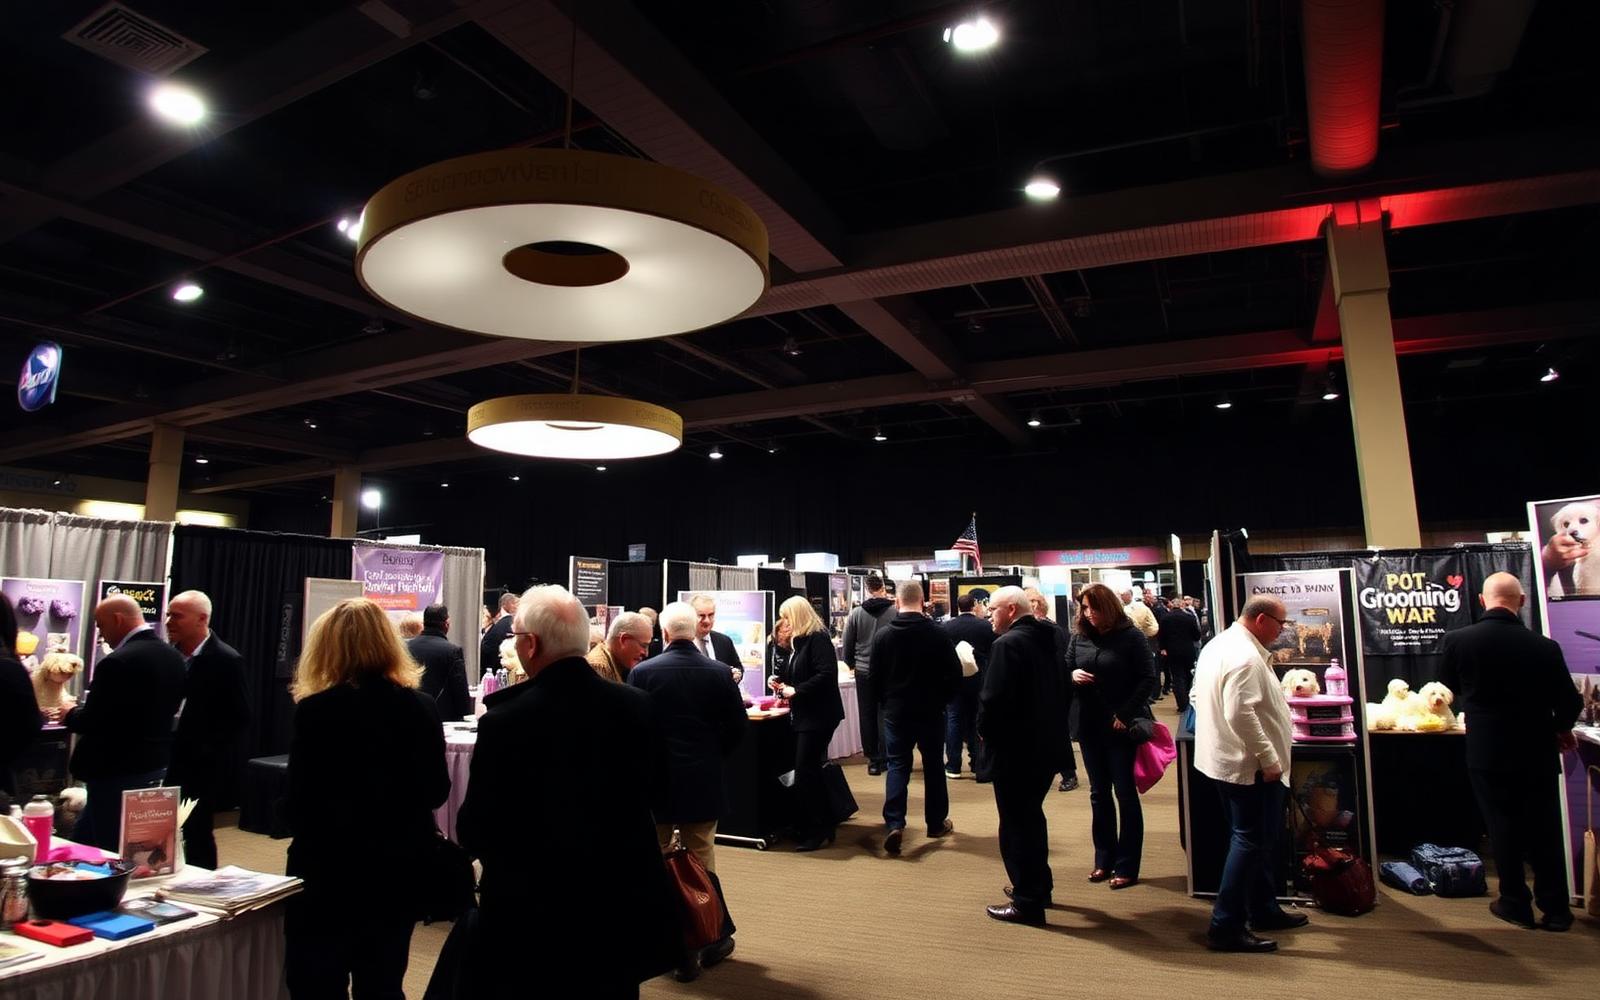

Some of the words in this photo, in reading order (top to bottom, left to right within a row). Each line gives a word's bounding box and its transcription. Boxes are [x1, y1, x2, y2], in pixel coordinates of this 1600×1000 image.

[1386, 572, 1426, 591] POT
[1360, 584, 1461, 612] Grooming
[1386, 607, 1436, 624] WAR
